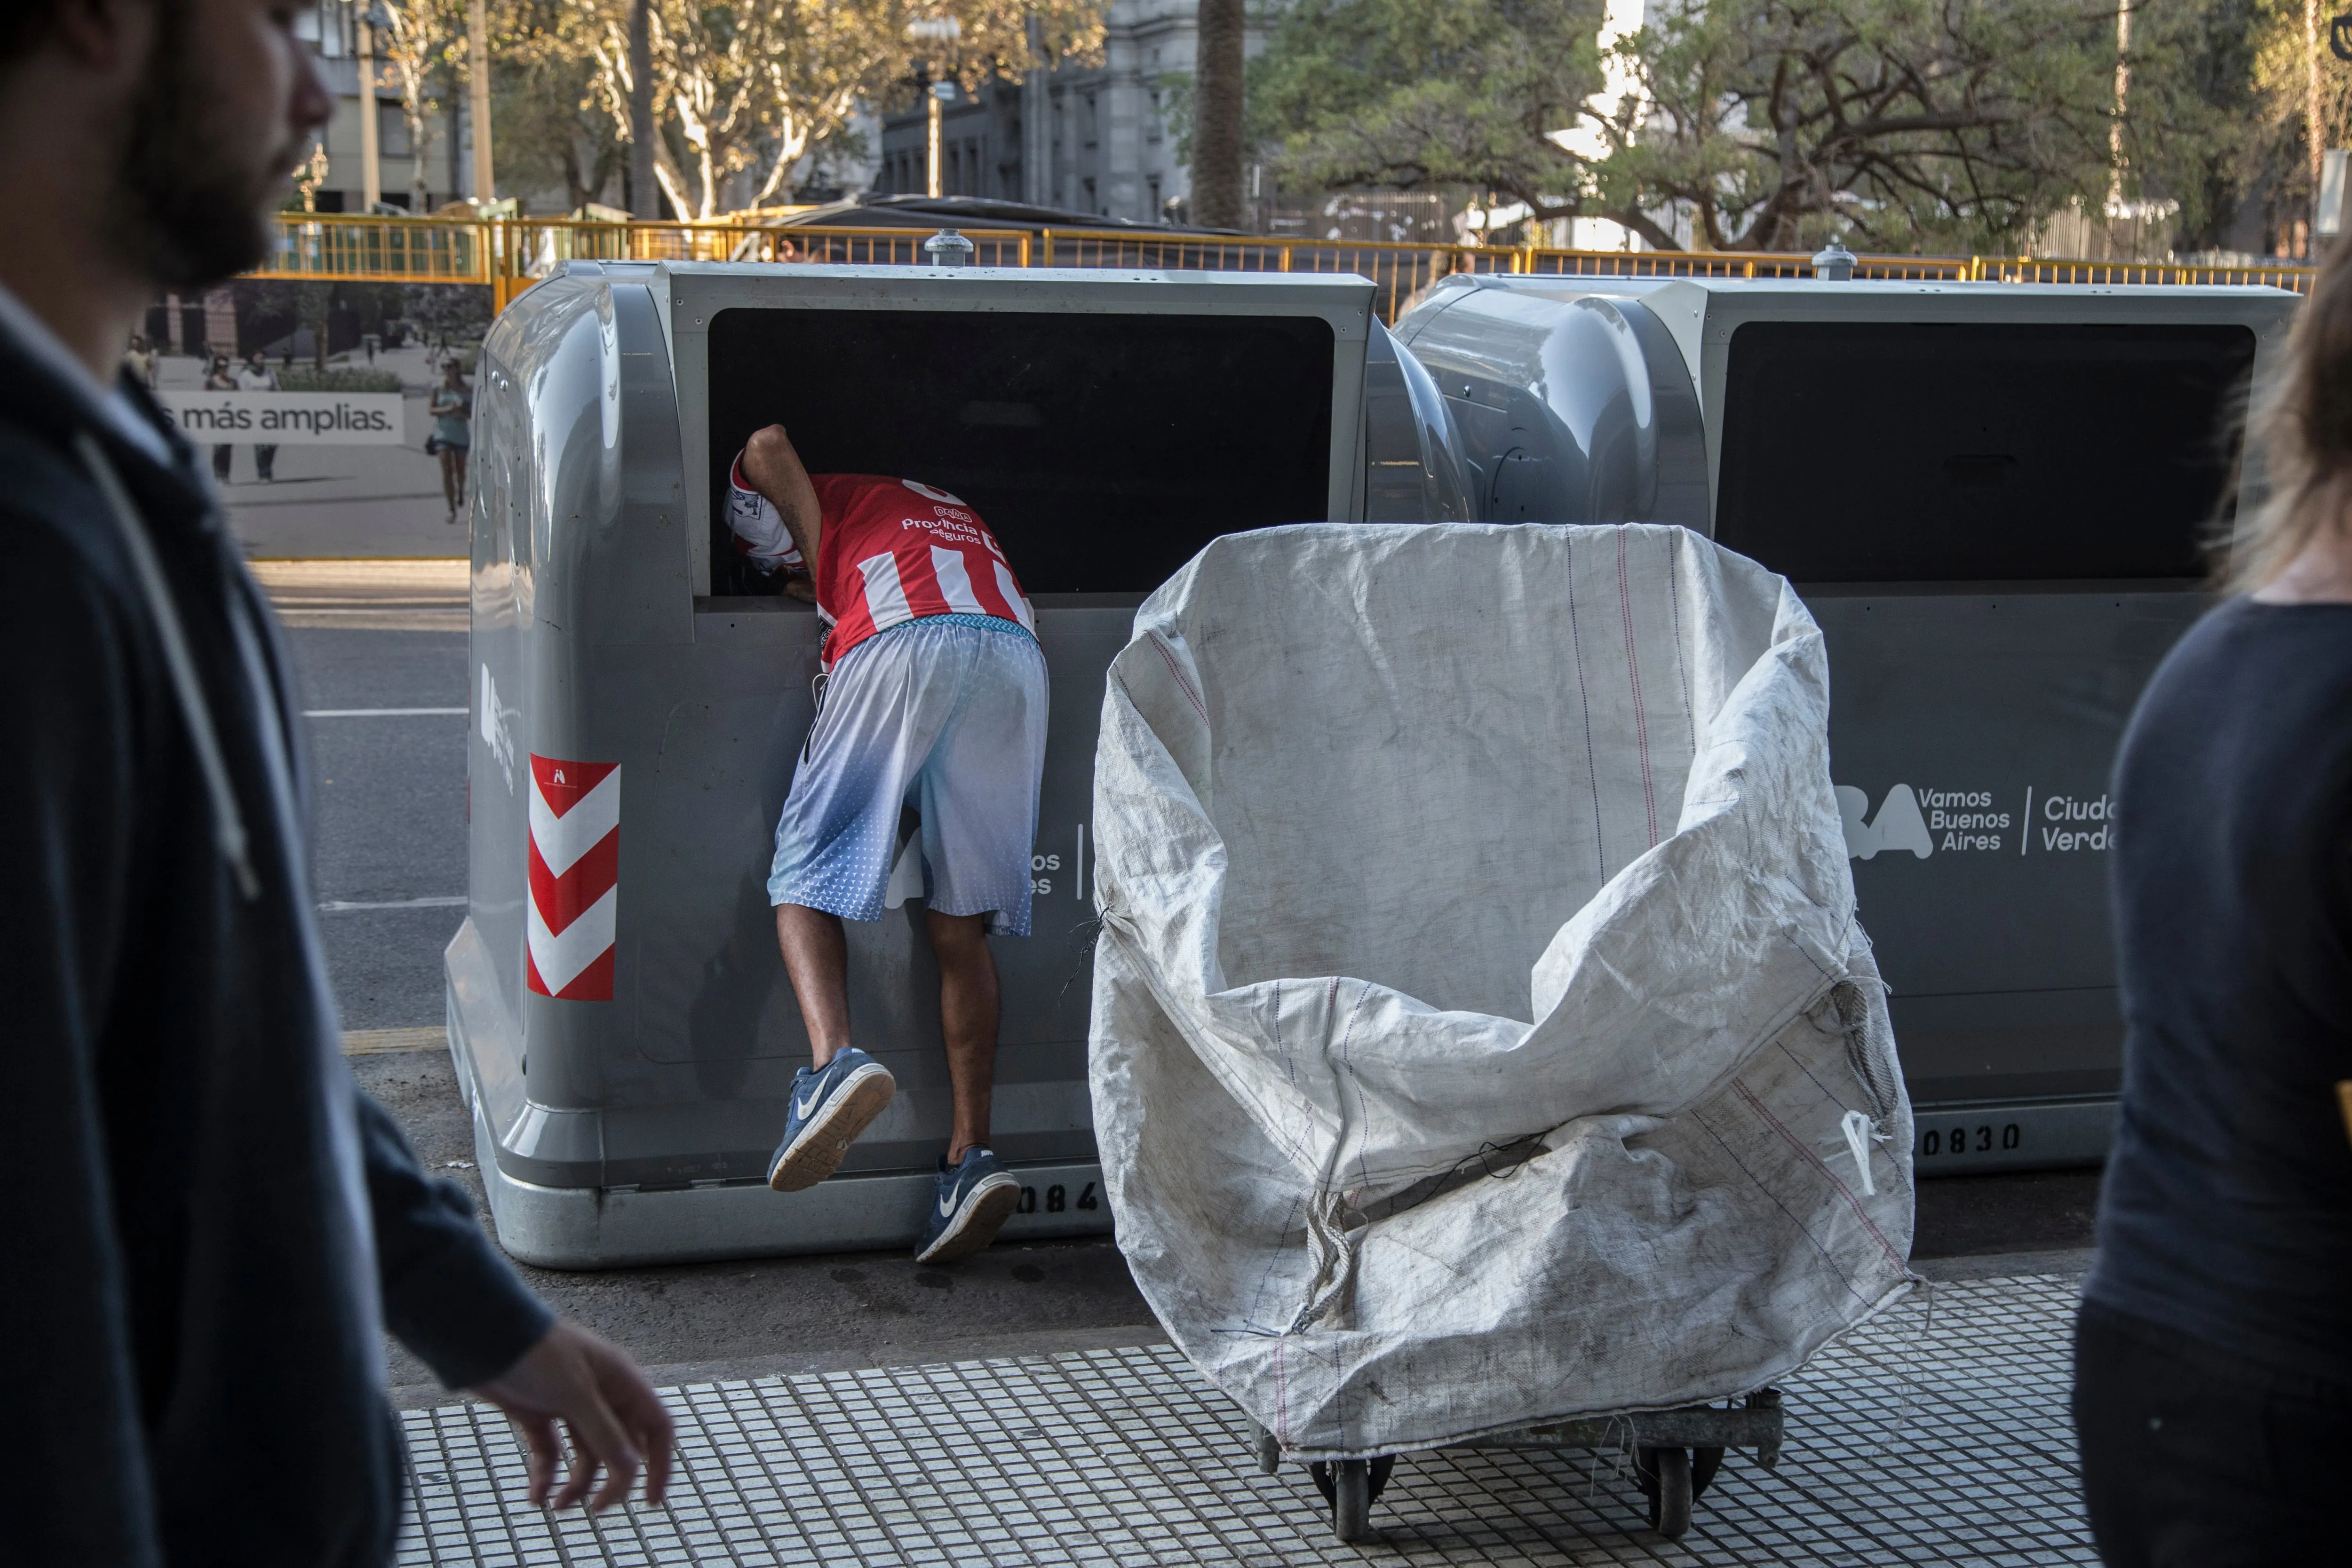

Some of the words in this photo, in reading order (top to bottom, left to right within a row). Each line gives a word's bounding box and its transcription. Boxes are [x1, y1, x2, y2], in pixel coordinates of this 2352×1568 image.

[183, 400, 252, 429] más
[260, 403, 393, 436] amplias.
[902, 518, 978, 535] Provincia
[1919, 788, 1992, 808] Vamos
[1931, 809, 2010, 829] Buenos
[1941, 831, 2001, 851] Aires
[1923, 1123, 2020, 1156] 0830
